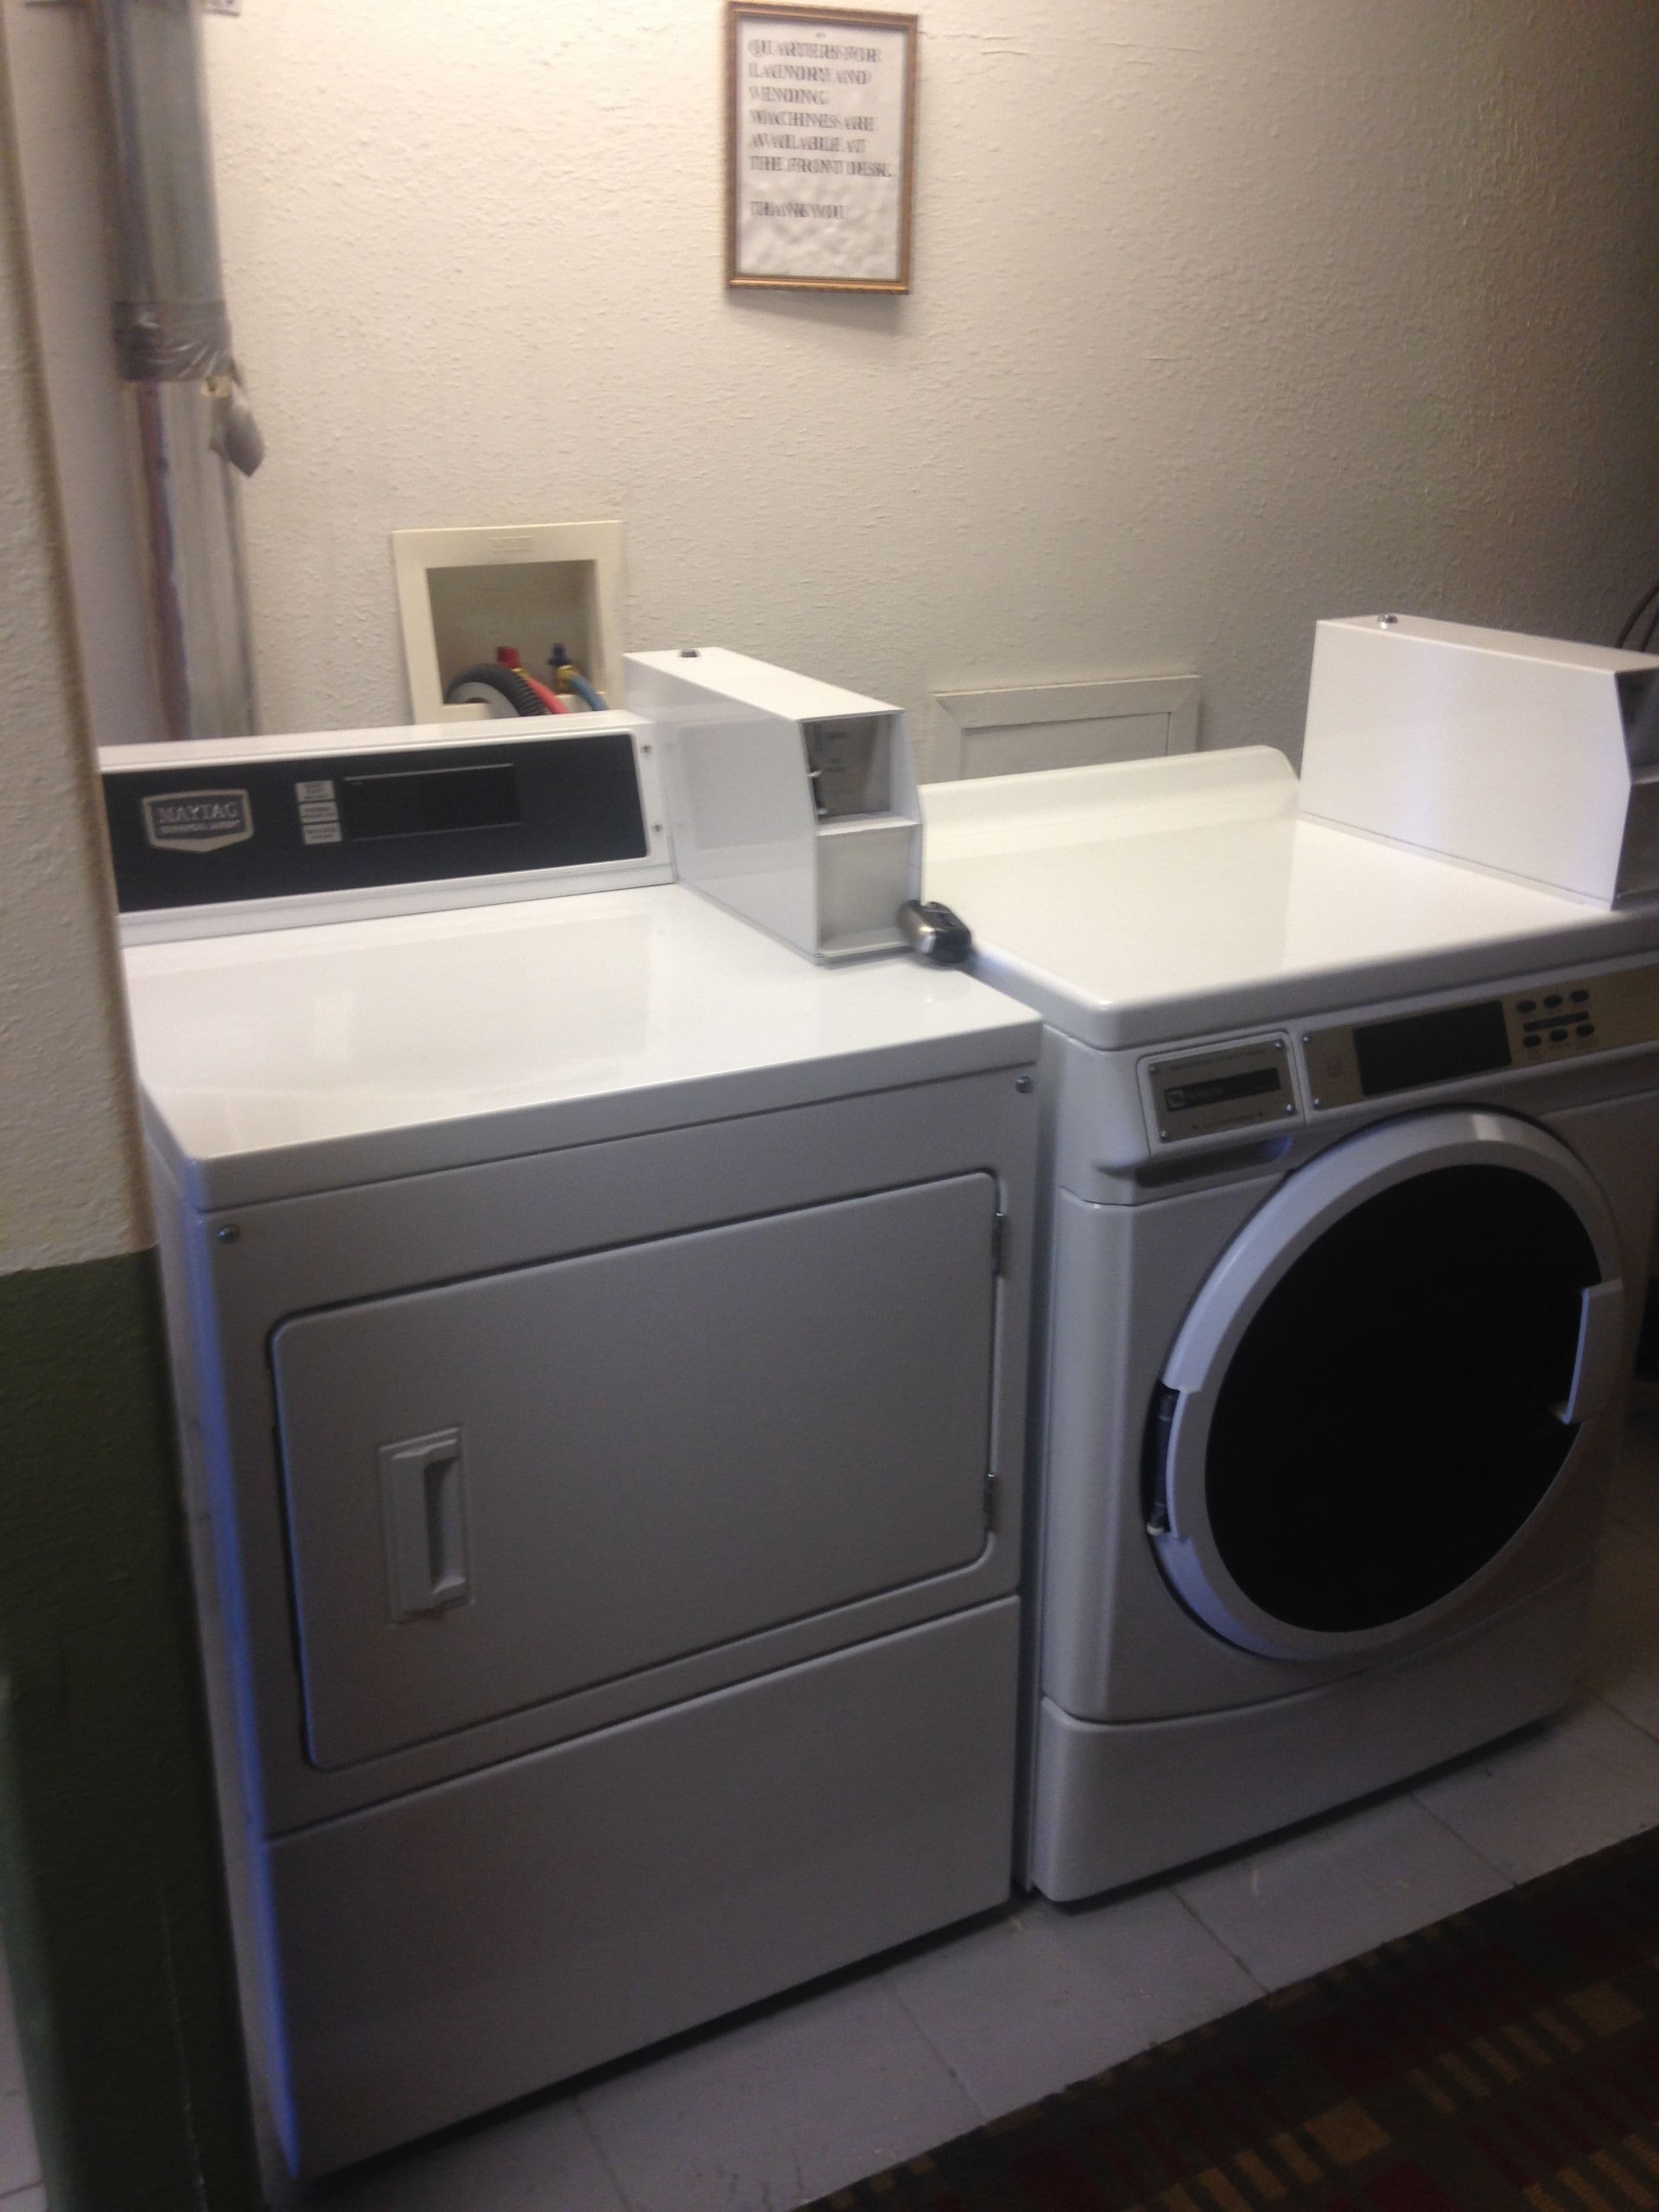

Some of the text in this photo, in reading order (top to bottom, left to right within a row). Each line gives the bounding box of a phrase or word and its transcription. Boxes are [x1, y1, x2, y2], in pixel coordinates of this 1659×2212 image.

[836, 69, 872, 84] AND
[748, 86, 829, 104] VENDING
[750, 109, 876, 131] MACHINES ARE
[750, 133, 844, 152] AVAILABLE
[749, 156, 783, 171] THE
[786, 157, 844, 174] FRONT
[157, 802, 238, 822] MAYTAG
